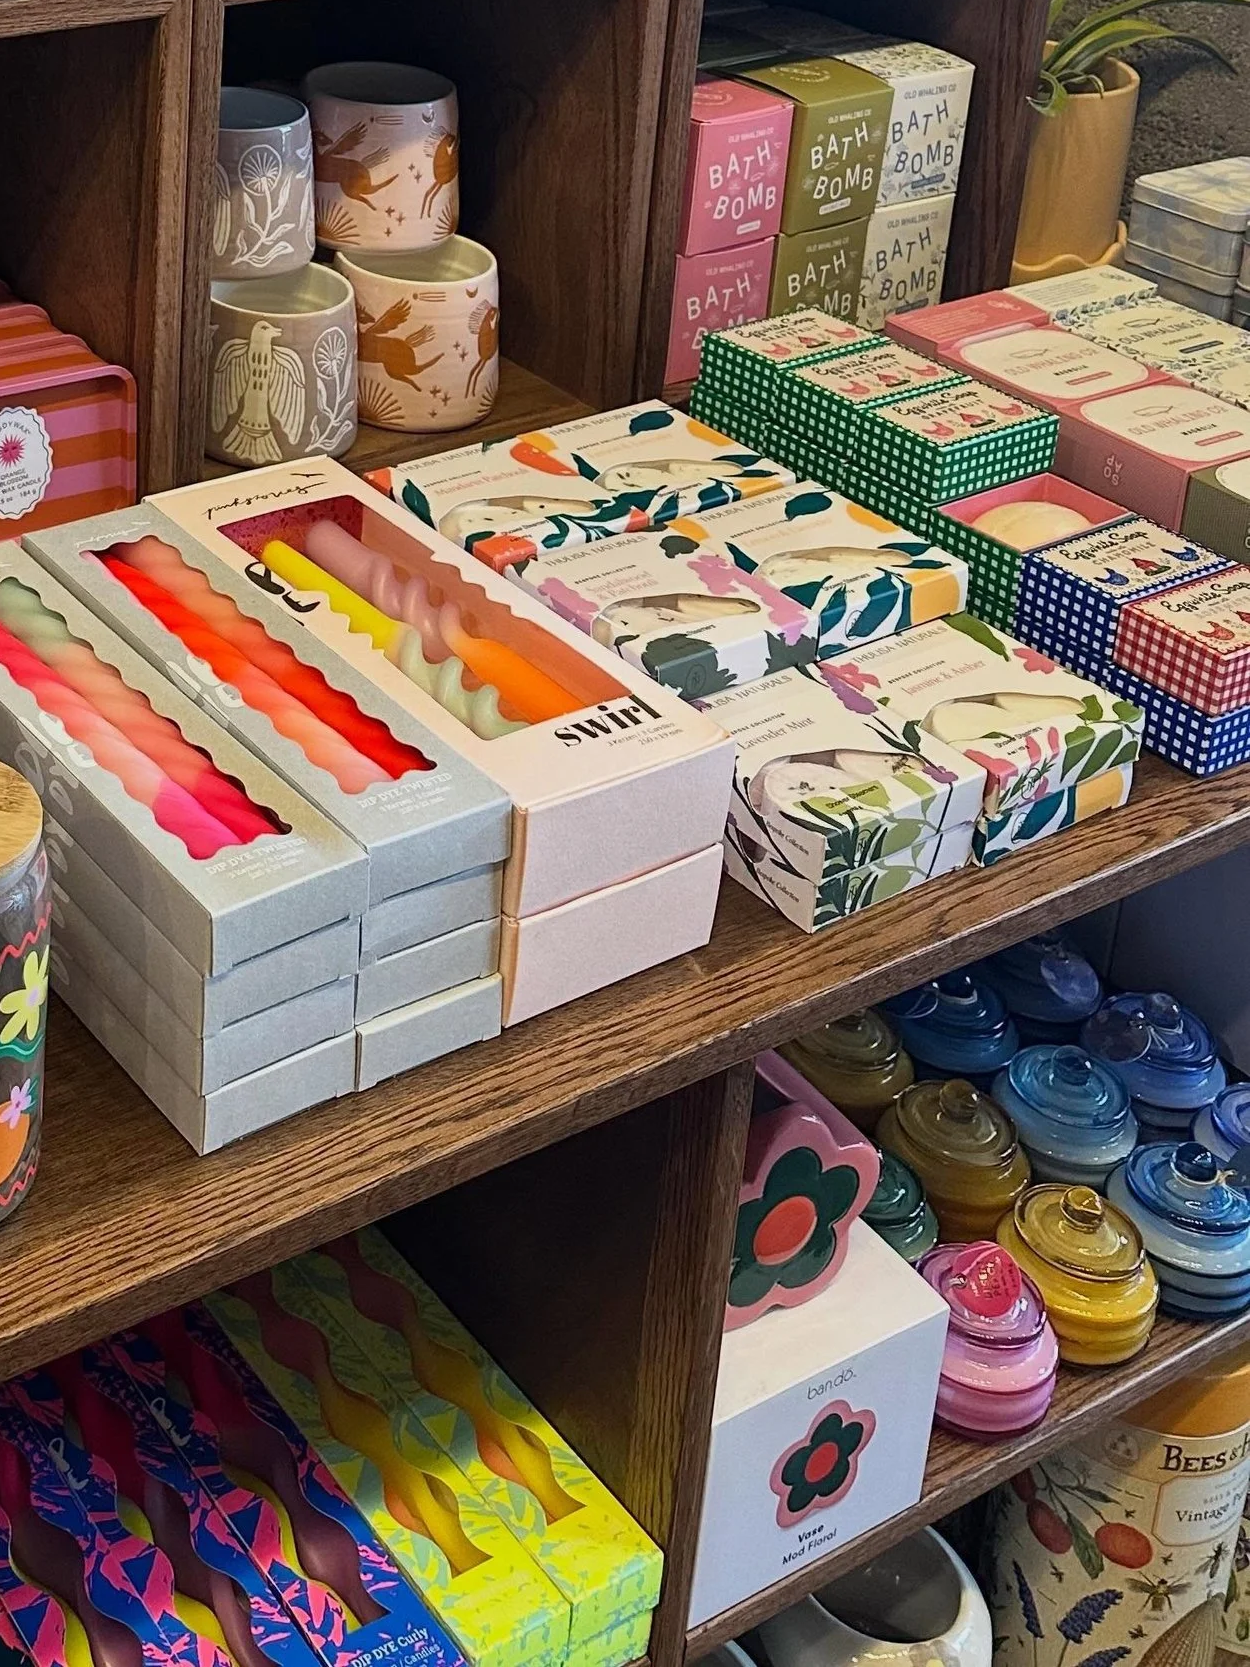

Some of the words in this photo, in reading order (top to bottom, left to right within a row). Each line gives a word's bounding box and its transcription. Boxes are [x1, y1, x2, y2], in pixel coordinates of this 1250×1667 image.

[904, 89, 917, 100] OLD
[918, 85, 947, 98] WHALING
[892, 98, 950, 146] BATH
[810, 121, 869, 170] BATH
[894, 140, 956, 175] BOMB
[709, 140, 772, 190] BATH
[813, 166, 874, 201] BOMB
[713, 182, 778, 220] BOMB
[887, 219, 899, 229] OLD
[901, 213, 929, 227] WHALING
[876, 226, 932, 272] BATH
[787, 249, 847, 297] BATH
[879, 268, 937, 301] BOMB
[686, 273, 751, 322] BATH
[761, 323, 820, 342] GRAPEFRUIT
[838, 360, 902, 379] GRAPEFRUIT
[1004, 363, 1027, 376] OLD
[1029, 350, 1085, 370] WHALING
[921, 398, 984, 420] GRAPEFRUIT
[1128, 422, 1152, 437] OLD
[1154, 407, 1212, 430] WHALING
[17, 477, 42, 489] CANDLE
[699, 507, 743, 523] THULISA
[744, 491, 795, 510] NATURALS
[543, 550, 590, 567] THULISA
[590, 535, 649, 555] NATURALS
[1108, 530, 1150, 545] Soap
[1092, 542, 1156, 566] CHAMOMILE
[853, 644, 897, 664] THULISA
[896, 626, 949, 649] NATURALS
[735, 674, 793, 699] NATURALS
[902, 677, 940, 696] Jasmine
[951, 660, 987, 678] Amber
[554, 693, 663, 747] swirl
[737, 725, 787, 750] Lavender
[787, 716, 815, 734] Mint
[356, 794, 379, 809] DIP
[378, 787, 402, 803] DYE
[401, 772, 453, 794] TWISTED
[229, 853, 252, 868] DYE
[251, 837, 308, 859] TWISTED
[1175, 1502, 1230, 1522] Vintage
[782, 1545, 805, 1565] Mod
[808, 1528, 837, 1551] Floral
[797, 1524, 824, 1543] Vase
[371, 1640, 398, 1661] DYE
[397, 1627, 429, 1647] Curly
[404, 1643, 440, 1665] Candles
